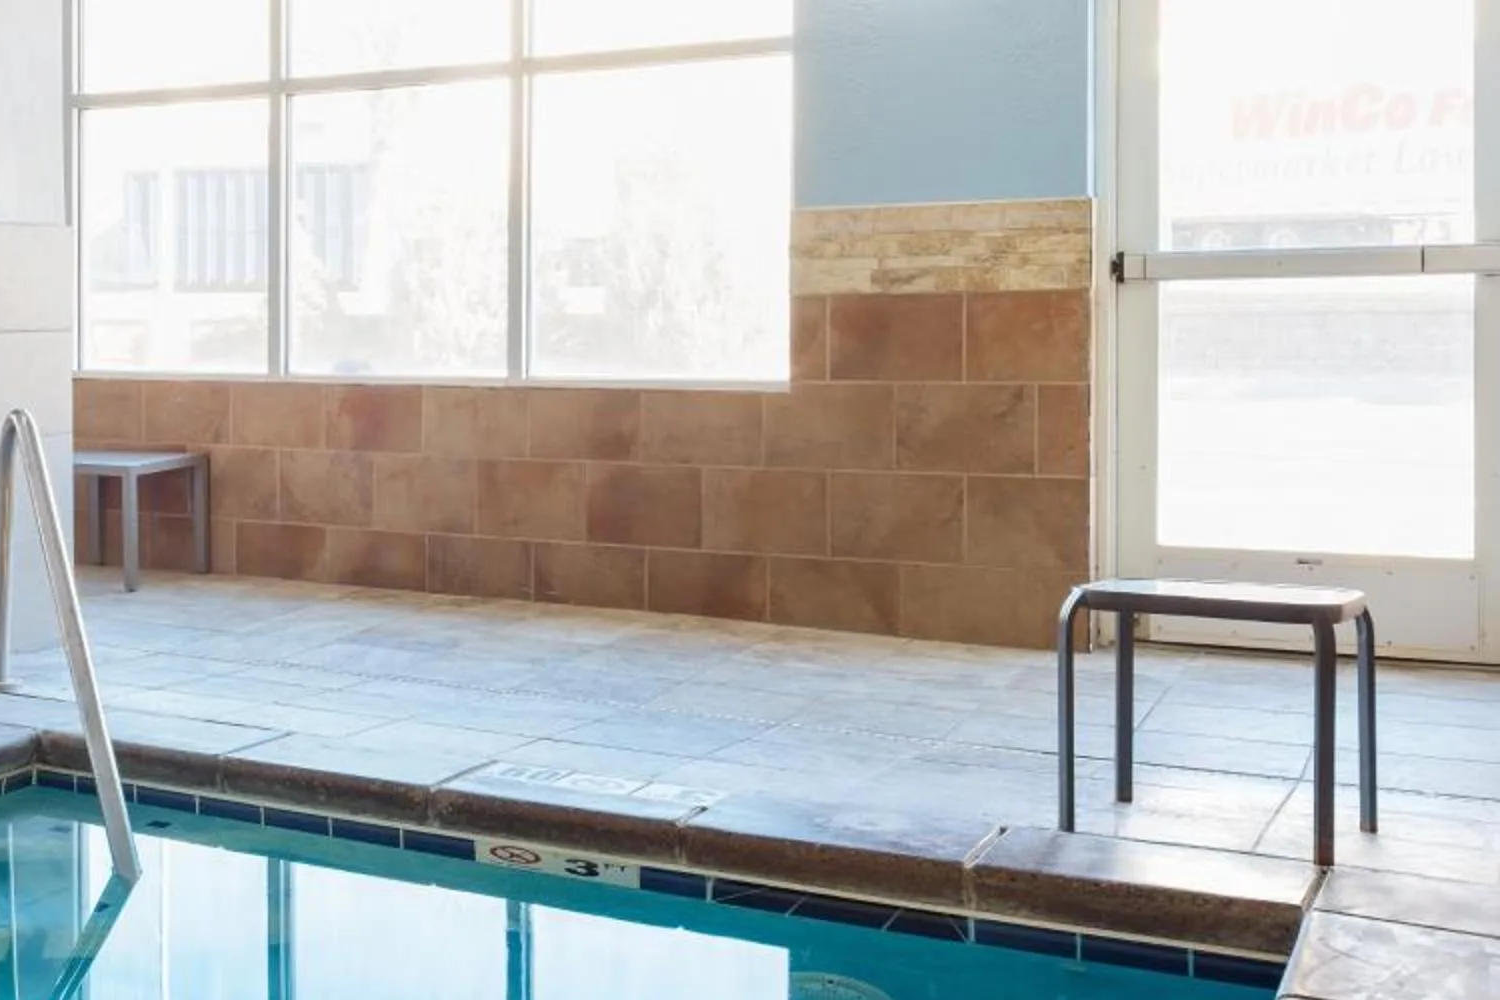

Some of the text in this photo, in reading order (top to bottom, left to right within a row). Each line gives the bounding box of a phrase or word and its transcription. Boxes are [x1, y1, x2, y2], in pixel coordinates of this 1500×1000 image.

[1231, 83, 1473, 141] WinCo F
[563, 858, 600, 877] 3
